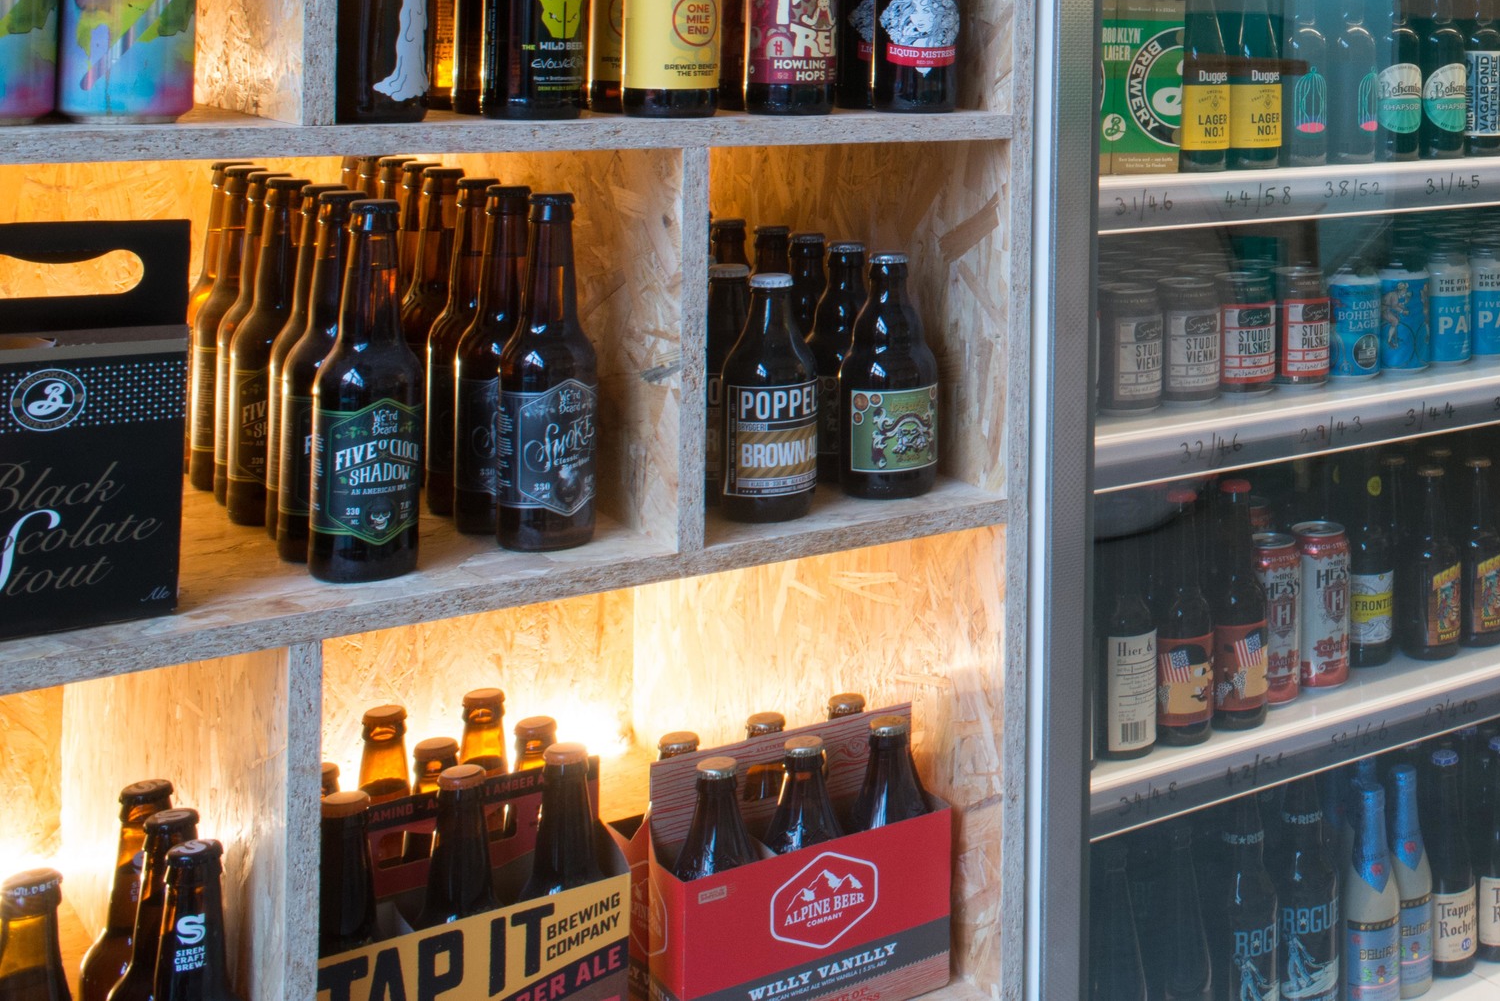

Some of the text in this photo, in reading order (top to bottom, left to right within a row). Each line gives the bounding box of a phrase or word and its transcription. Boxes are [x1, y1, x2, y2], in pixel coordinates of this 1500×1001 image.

[687, 3, 711, 14] ONE
[685, 13, 711, 25] MILE
[687, 24, 710, 36] END
[889, 46, 919, 59] LIQUID
[1104, 45, 1131, 61] LAGER
[664, 63, 696, 71] BREWED
[773, 59, 827, 70] HOWLING
[676, 69, 690, 77] THE
[795, 70, 826, 82] HOPS
[1199, 69, 1228, 85] Dugges
[1251, 69, 1280, 84] Dugges
[1128, 39, 1163, 132] BREWERY
[1480, 55, 1490, 131] VAGABOND
[1198, 113, 1228, 126] LAGER
[1251, 112, 1280, 124] LAGER
[1204, 126, 1225, 138] NO.1
[1256, 124, 1277, 136] NO.1
[1238, 327, 1271, 343] STUDIO
[1185, 335, 1217, 350] STUDIO
[334, 441, 377, 472] FIVE
[741, 439, 807, 469] BROWN
[348, 462, 411, 487] SHADOW
[362, 485, 396, 495] AMERICAN
[533, 482, 551, 493] 330
[345, 506, 361, 516] 330
[546, 891, 621, 941] BREWING
[784, 892, 865, 927] ALPINE BEER
[806, 911, 844, 928] COMPANY
[546, 910, 621, 962] COMPANY
[175, 945, 206, 958] SIREN
[488, 902, 556, 998] IT
[174, 953, 206, 965] CRAFT
[576, 943, 622, 988] ALE
[748, 942, 897, 1001] WILLY VANILLY
